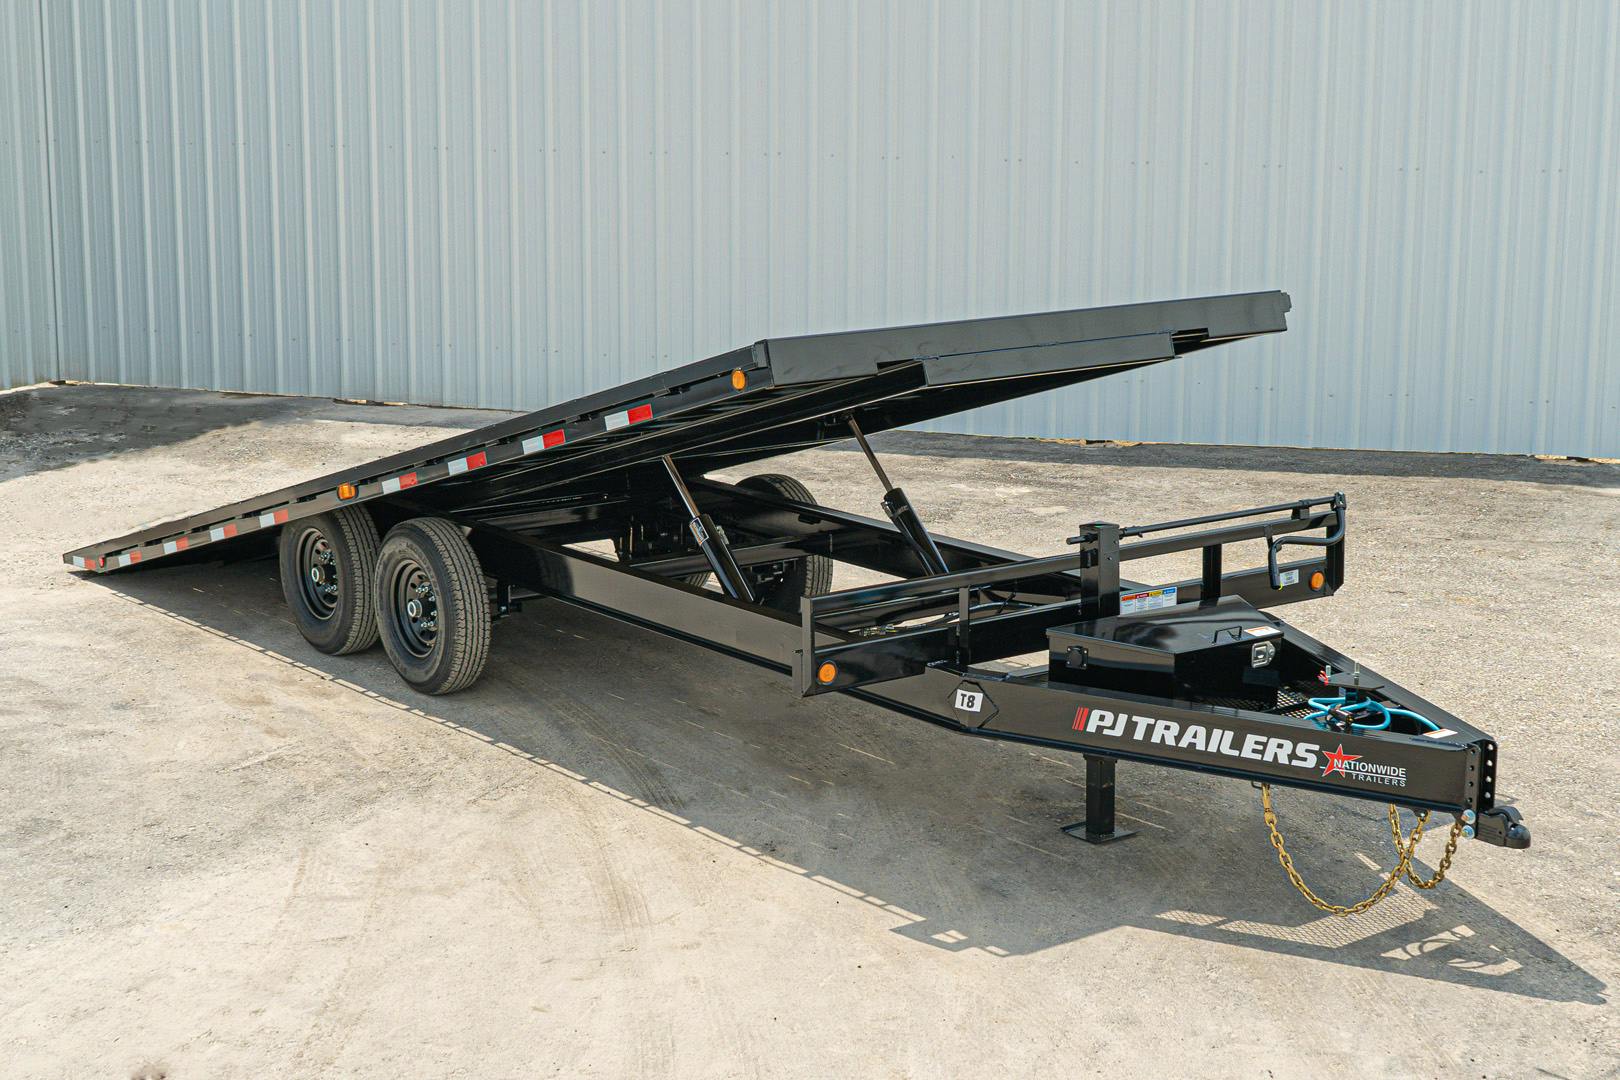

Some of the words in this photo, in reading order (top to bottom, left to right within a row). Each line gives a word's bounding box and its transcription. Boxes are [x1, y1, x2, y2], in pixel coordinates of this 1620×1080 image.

[960, 693, 976, 709] T8
[1086, 709, 1128, 737] PJ
[1131, 715, 1320, 769] TRAILERS
[1333, 758, 1407, 778] NATIONWIDE
[1351, 772, 1406, 787] TRAILERS
